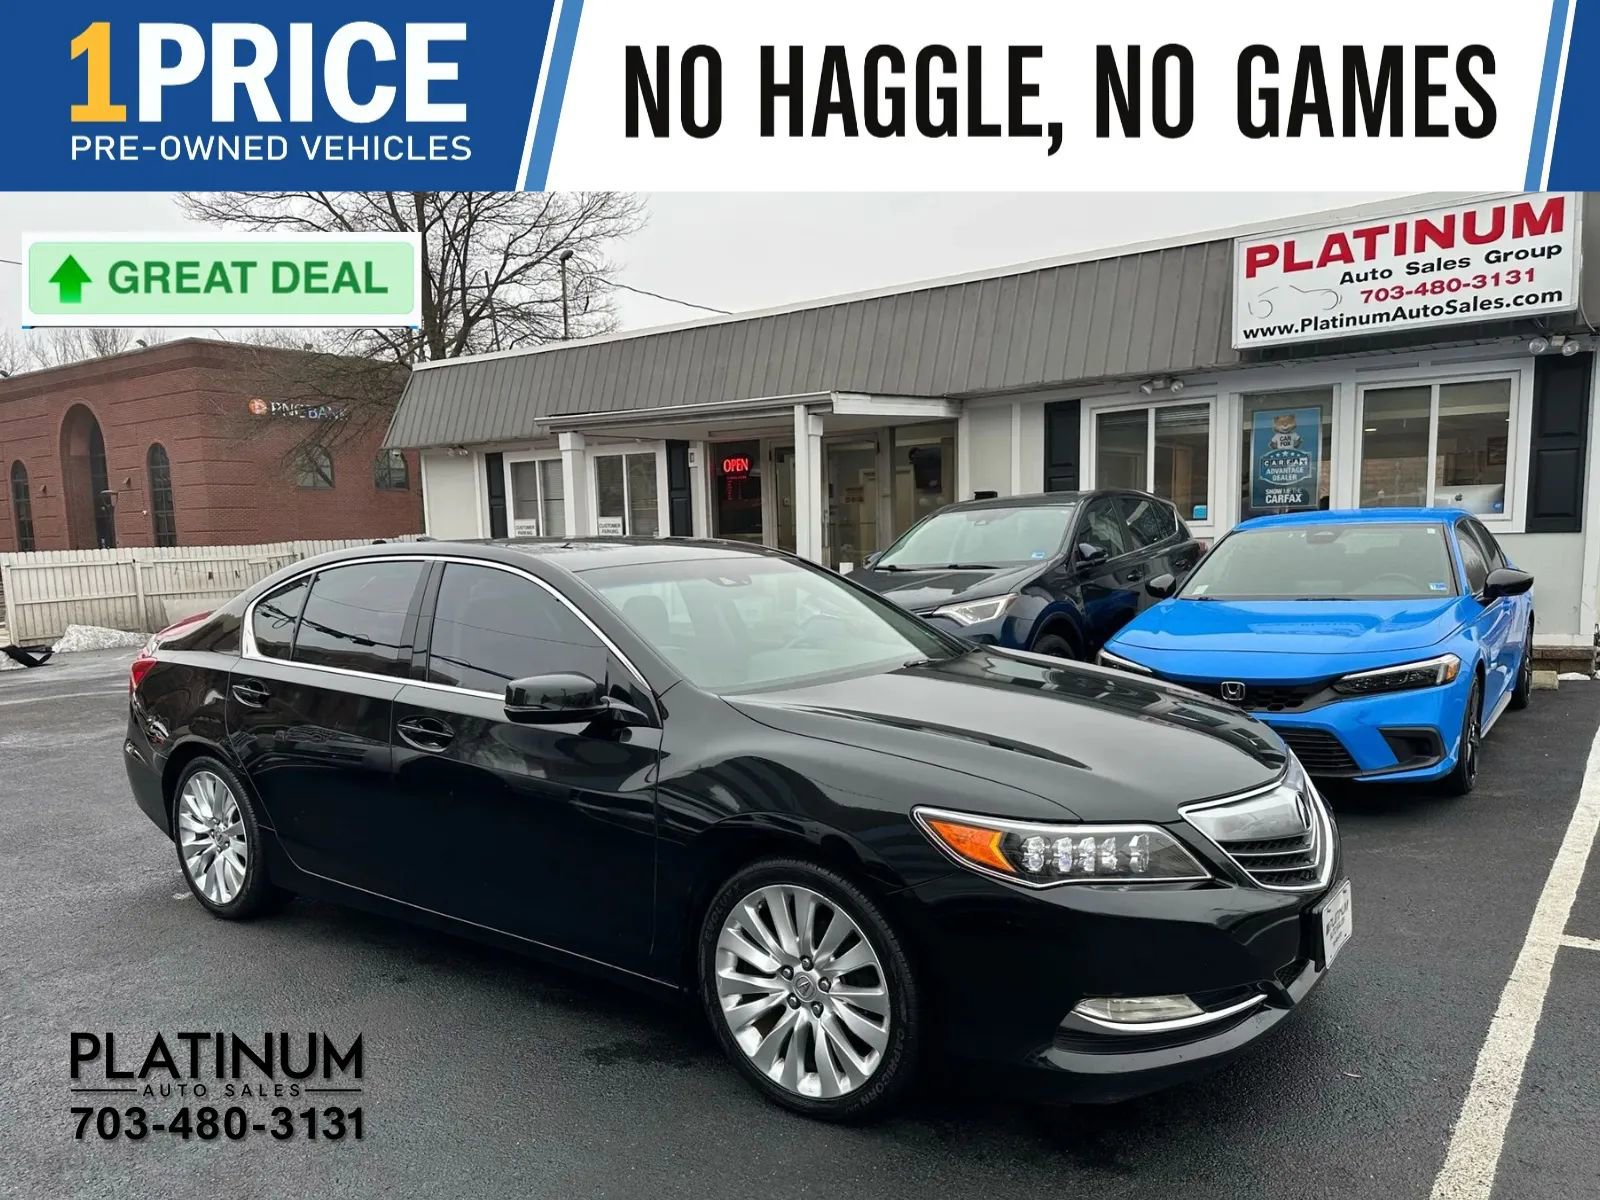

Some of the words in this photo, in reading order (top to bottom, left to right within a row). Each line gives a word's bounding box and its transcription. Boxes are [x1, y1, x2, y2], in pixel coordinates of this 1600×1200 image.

[1246, 197, 1565, 278] PLATINUM
[1339, 267, 1393, 285] Auto
[1406, 256, 1471, 276] Sales
[1484, 243, 1563, 266] Group
[1360, 267, 1536, 304] 703-480-3131
[1243, 289, 1563, 340] www.PlatinumAutoSales.com
[723, 458, 749, 473] OPEN
[1264, 458, 1307, 466] CARFAX
[1265, 467, 1304, 475] ADVANTAGE
[1265, 494, 1302, 503] CARFAX
